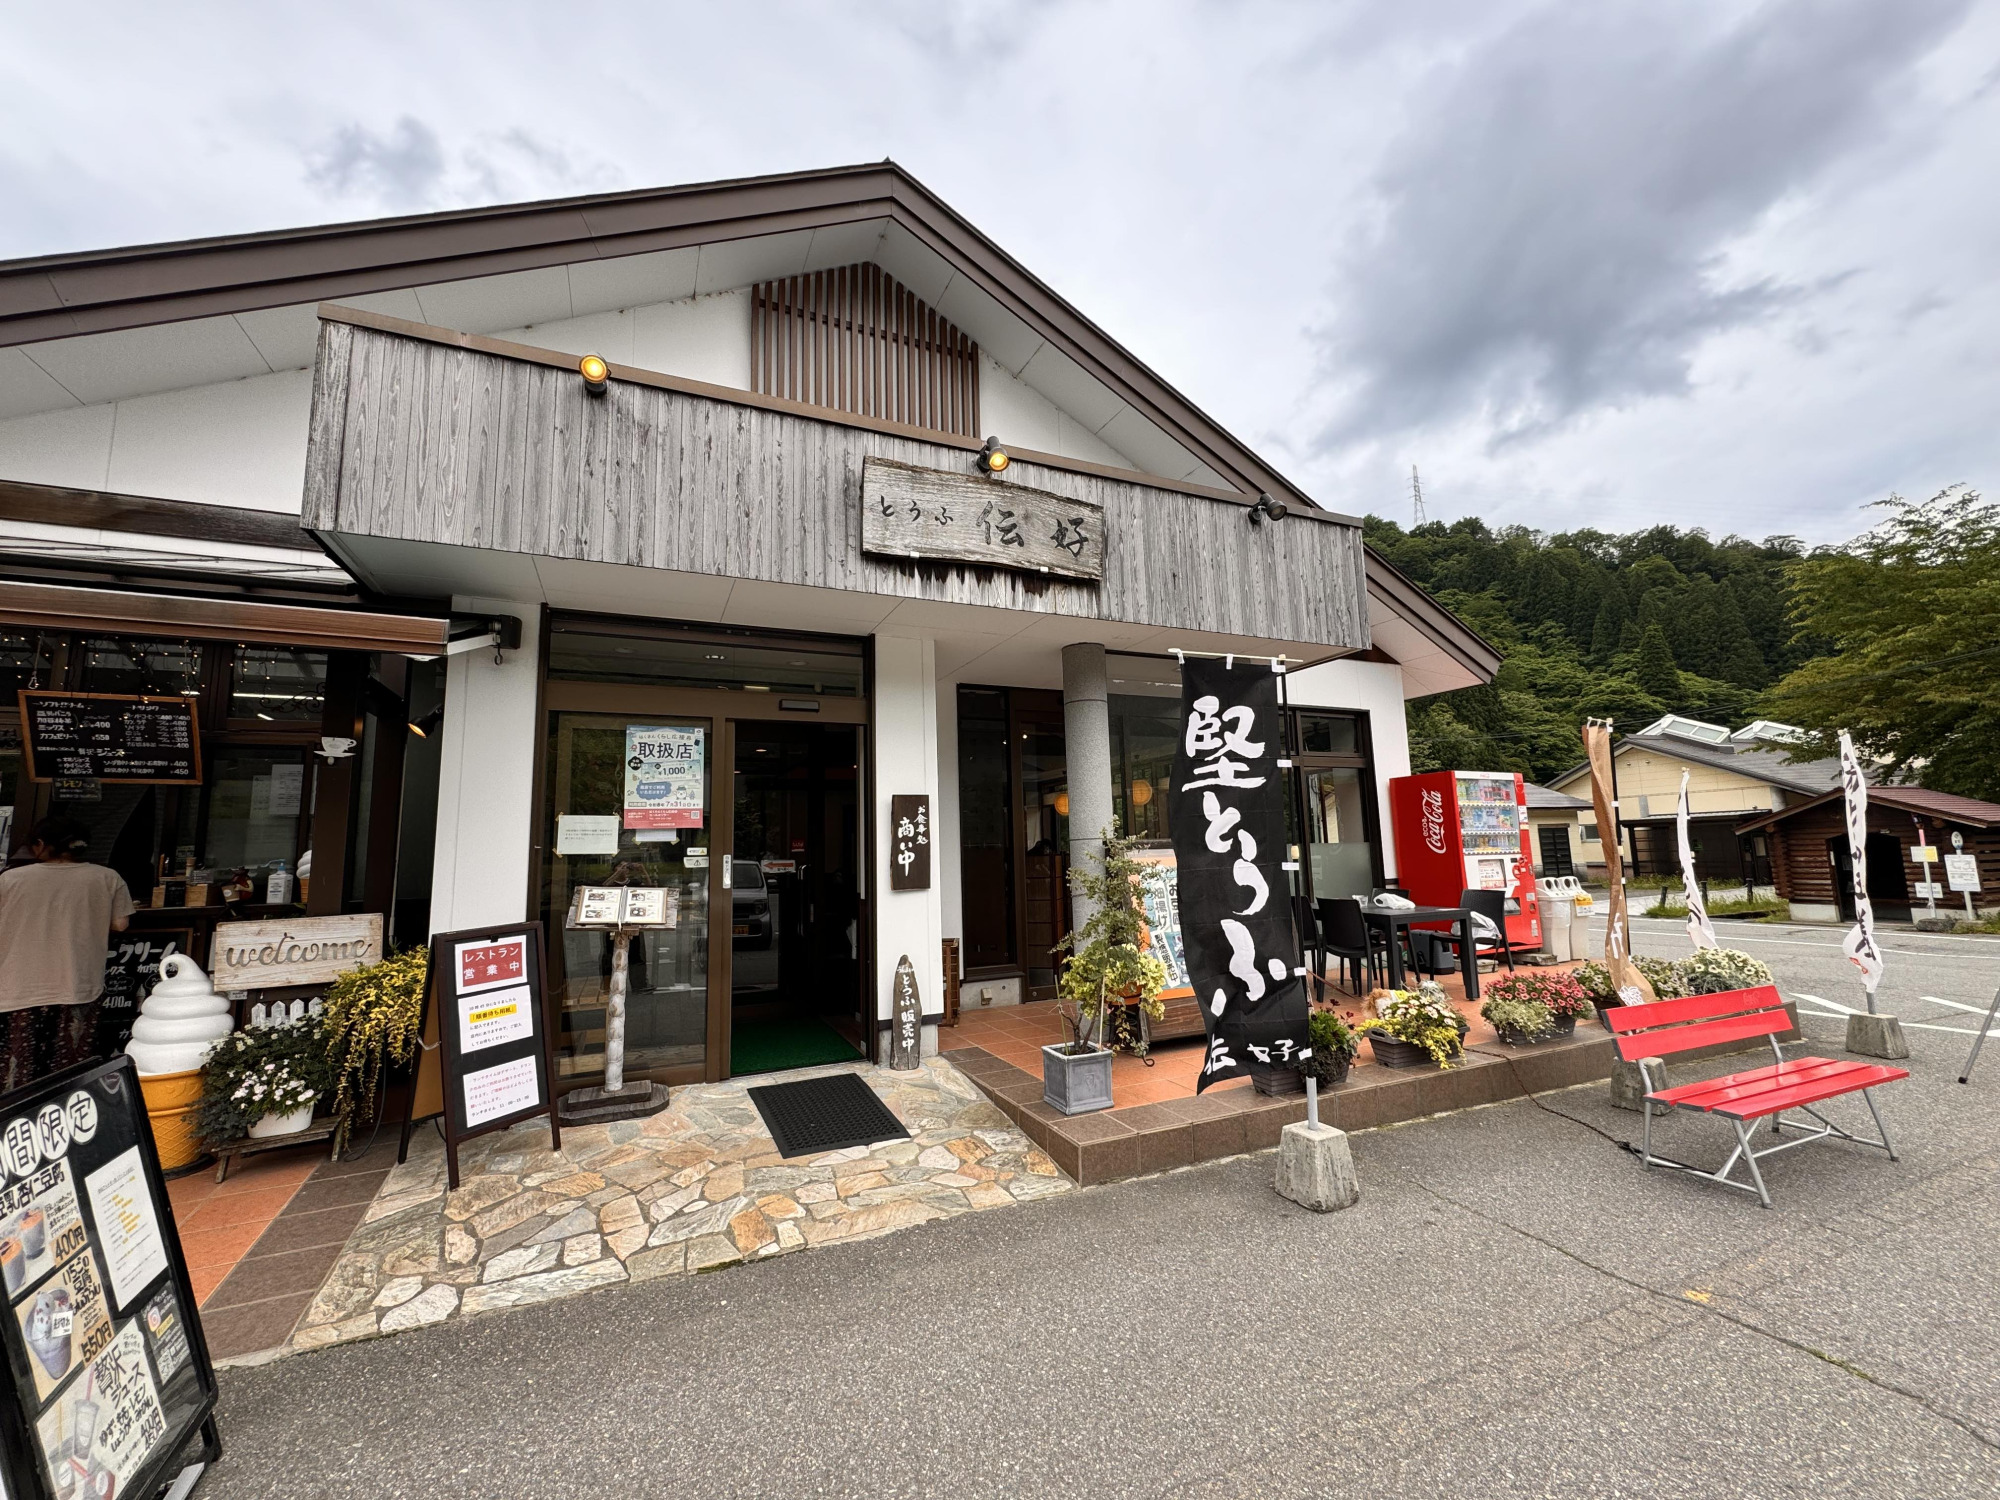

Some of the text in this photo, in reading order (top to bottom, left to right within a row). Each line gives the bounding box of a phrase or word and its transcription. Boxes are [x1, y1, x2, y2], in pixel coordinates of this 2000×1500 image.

[881, 495, 1089, 558] とうふ 伝好
[638, 742, 694, 760] 取扱店
[63, 780, 82, 788] レモン
[913, 804, 929, 845] お食事処
[897, 816, 916, 877] 商い中
[1181, 695, 1287, 1016] 堅とうふ
[226, 932, 373, 968] welcome
[463, 961, 520, 980] 営業中
[465, 947, 519, 963] レストラン
[900, 974, 916, 1007] とうふ
[901, 1009, 916, 1053] 販売中
[0, 1093, 96, 1180] 間限定
[56, 1225, 85, 1260] 400円
[81, 1320, 112, 1363] 550円
[94, 1344, 127, 1400] 贅沢
[110, 1361, 145, 1409] ジュース
